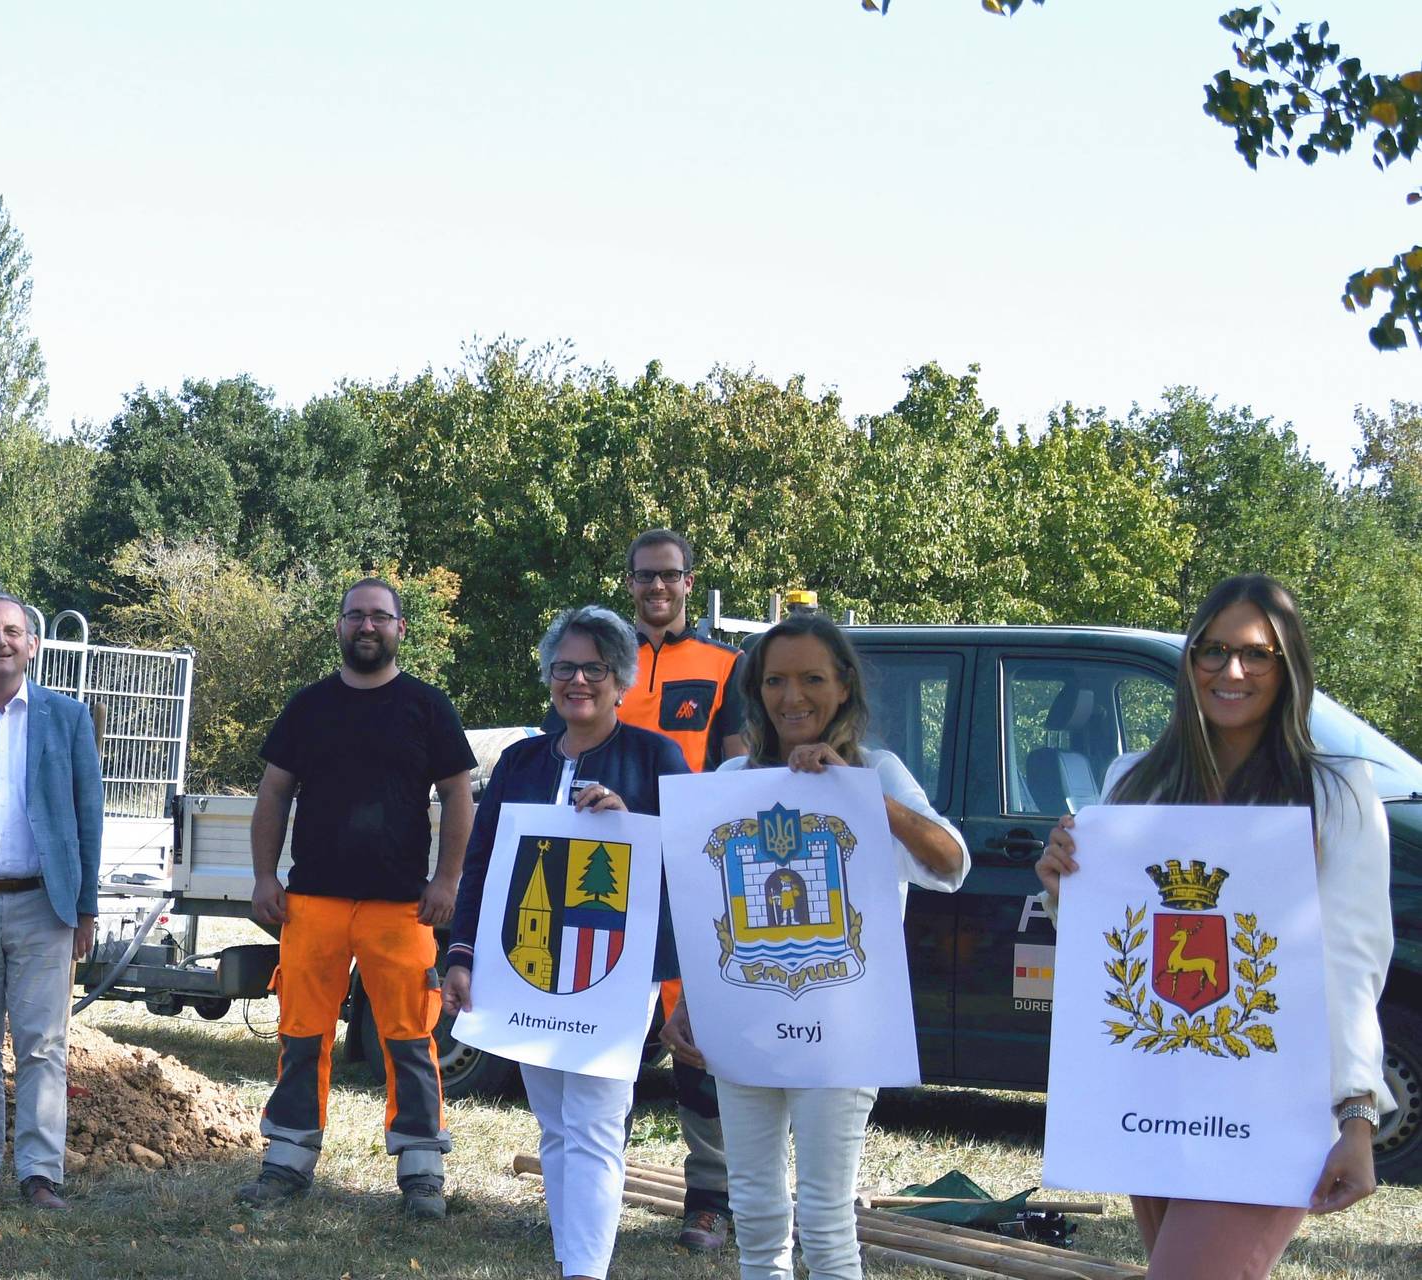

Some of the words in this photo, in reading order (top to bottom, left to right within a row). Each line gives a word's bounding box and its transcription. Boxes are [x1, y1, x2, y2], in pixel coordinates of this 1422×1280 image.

[507, 1012, 598, 1035] Altmünster
[776, 1021, 822, 1043] Stryj
[1121, 1112, 1251, 1139] Cormeilles
